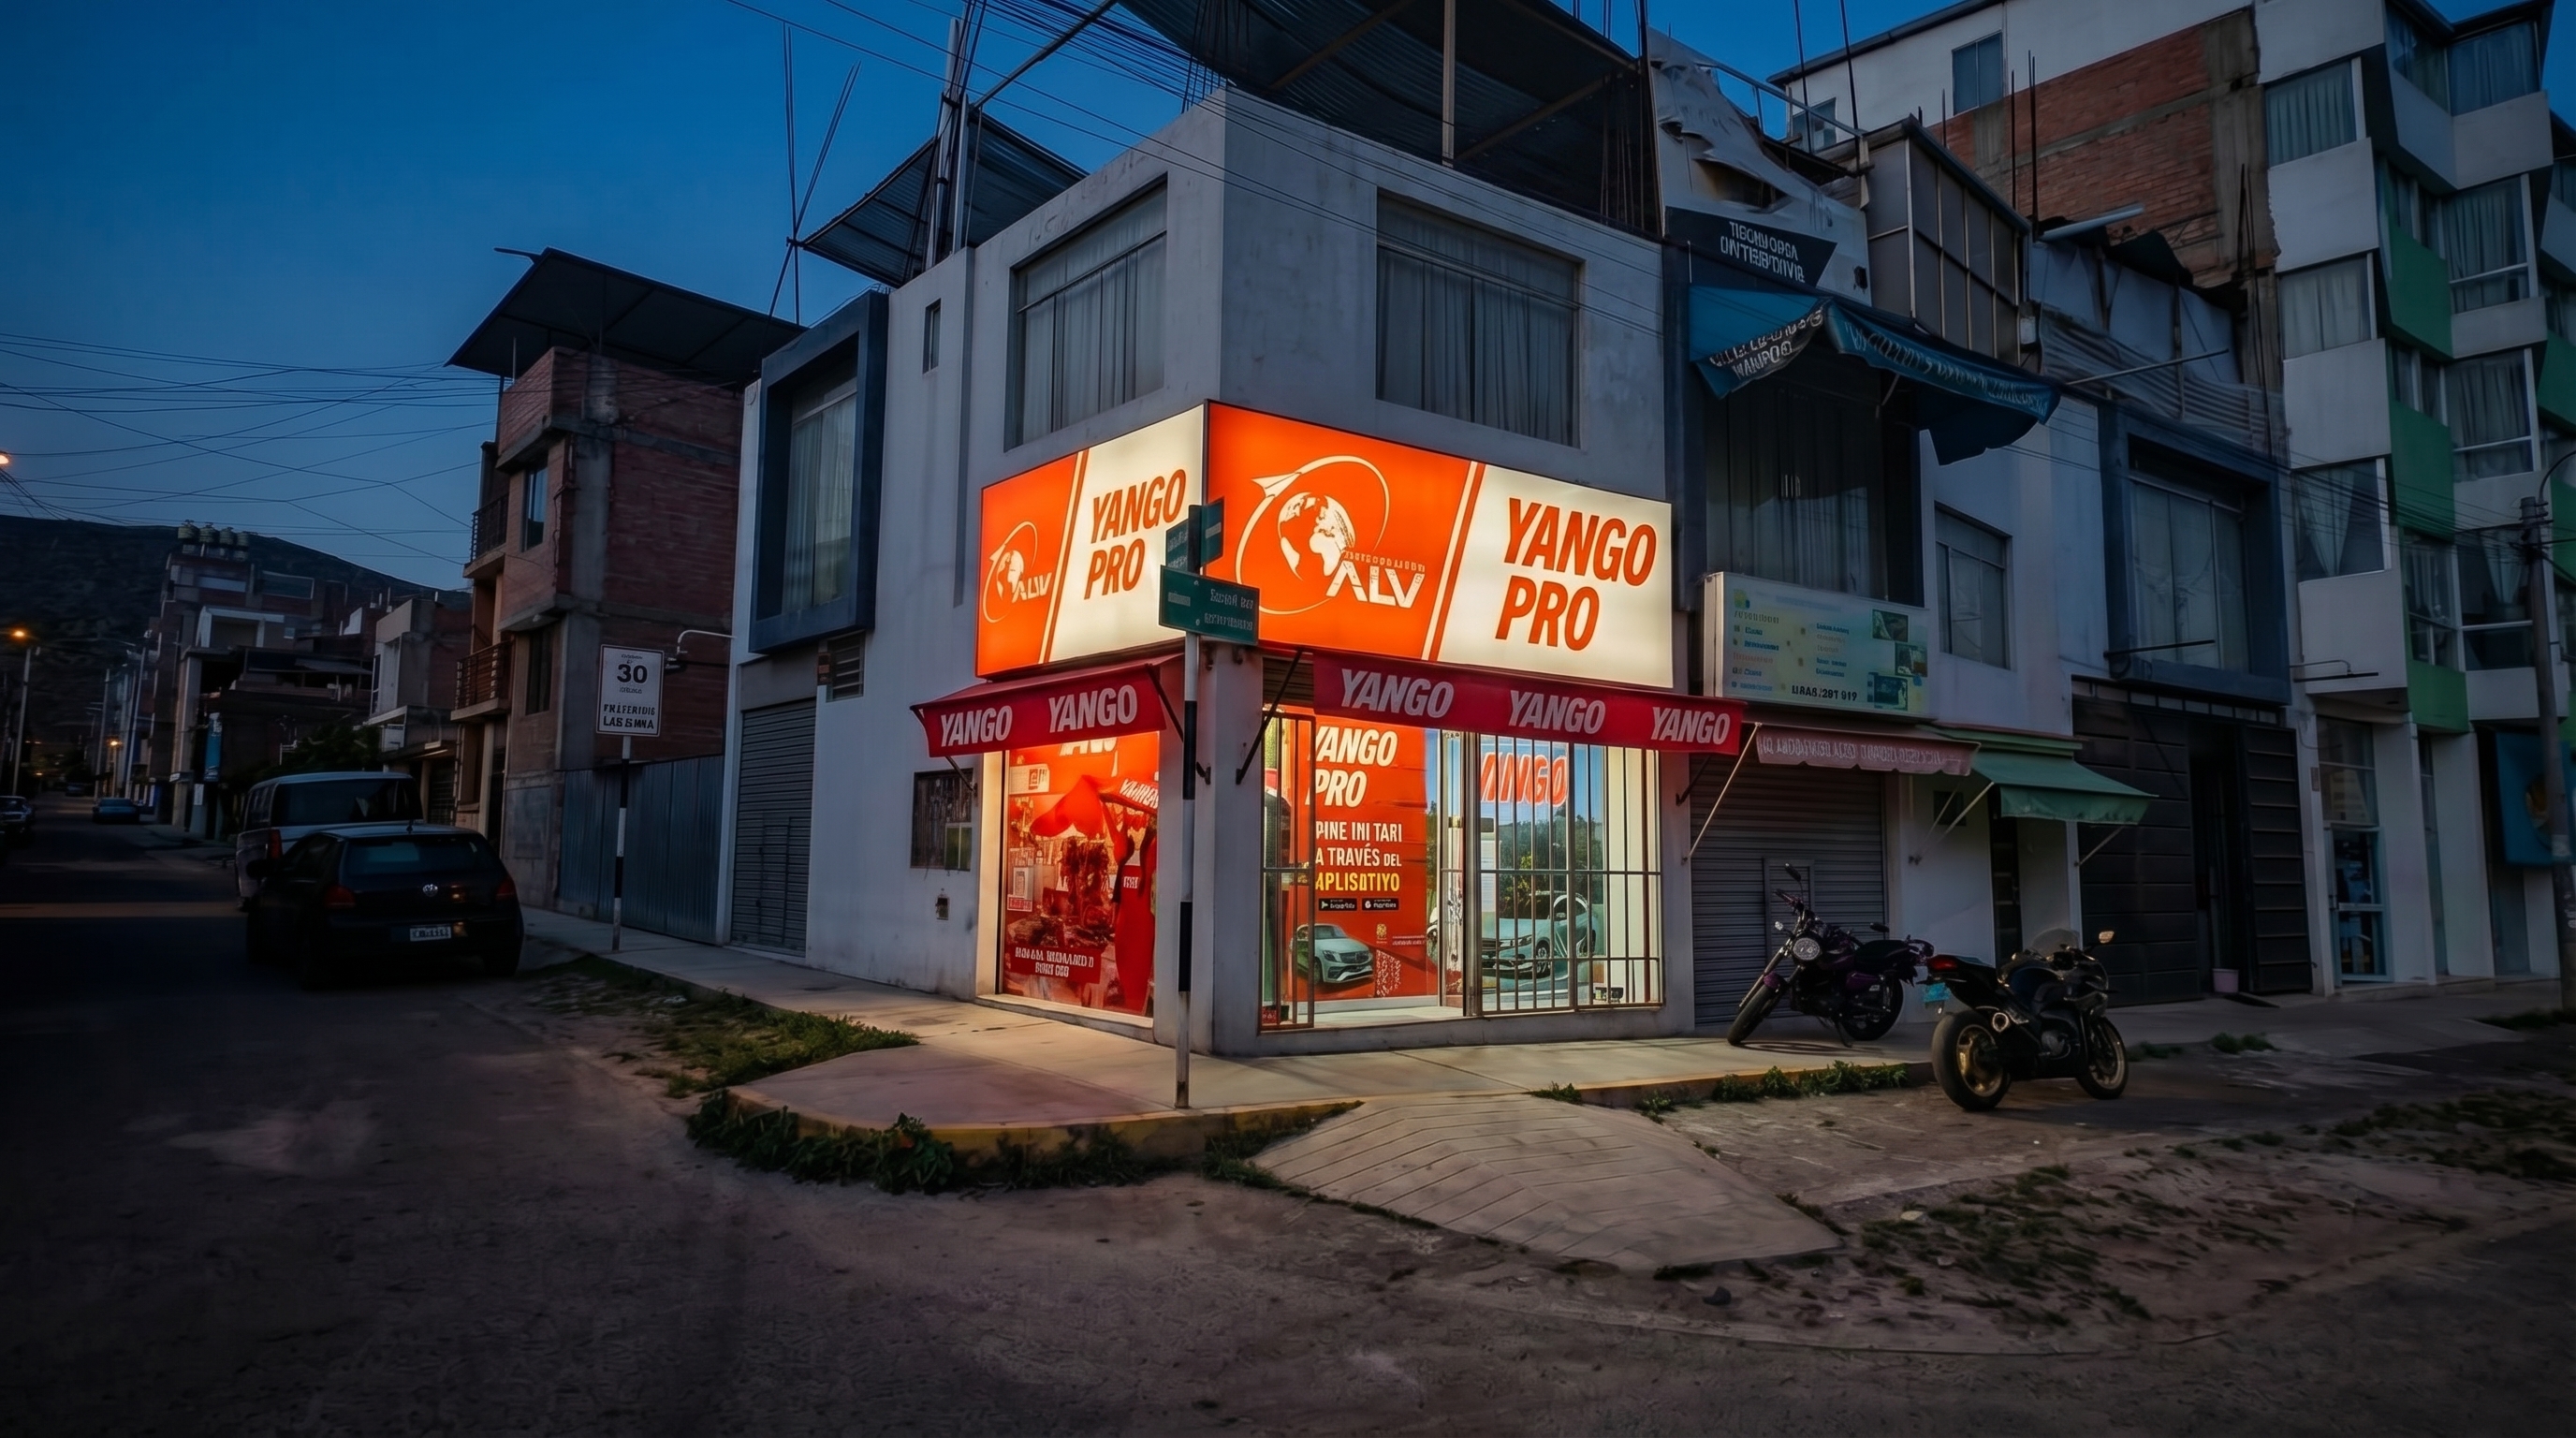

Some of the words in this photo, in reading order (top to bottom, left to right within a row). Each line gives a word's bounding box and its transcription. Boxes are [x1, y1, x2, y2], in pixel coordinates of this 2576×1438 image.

[1090, 468, 1187, 544] YANGO
[1503, 496, 1658, 587] YANGO
[1084, 538, 1146, 601] PRO
[1325, 560, 1426, 609] ALV
[1494, 575, 1601, 652] PRO
[617, 664, 648, 683] 30
[940, 705, 1013, 748] YANGO
[1048, 684, 1138, 734] YANGO
[1340, 668, 1455, 718] YANGO
[1508, 689, 1606, 735] YANGO
[1650, 706, 1731, 746] YANGO
[1305, 769, 1368, 808] PRO
[1481, 752, 1568, 808] ANGO
[1315, 847, 1325, 866] A
[1327, 843, 1381, 867] TRAVÉS
[1383, 854, 1402, 867] DEL
